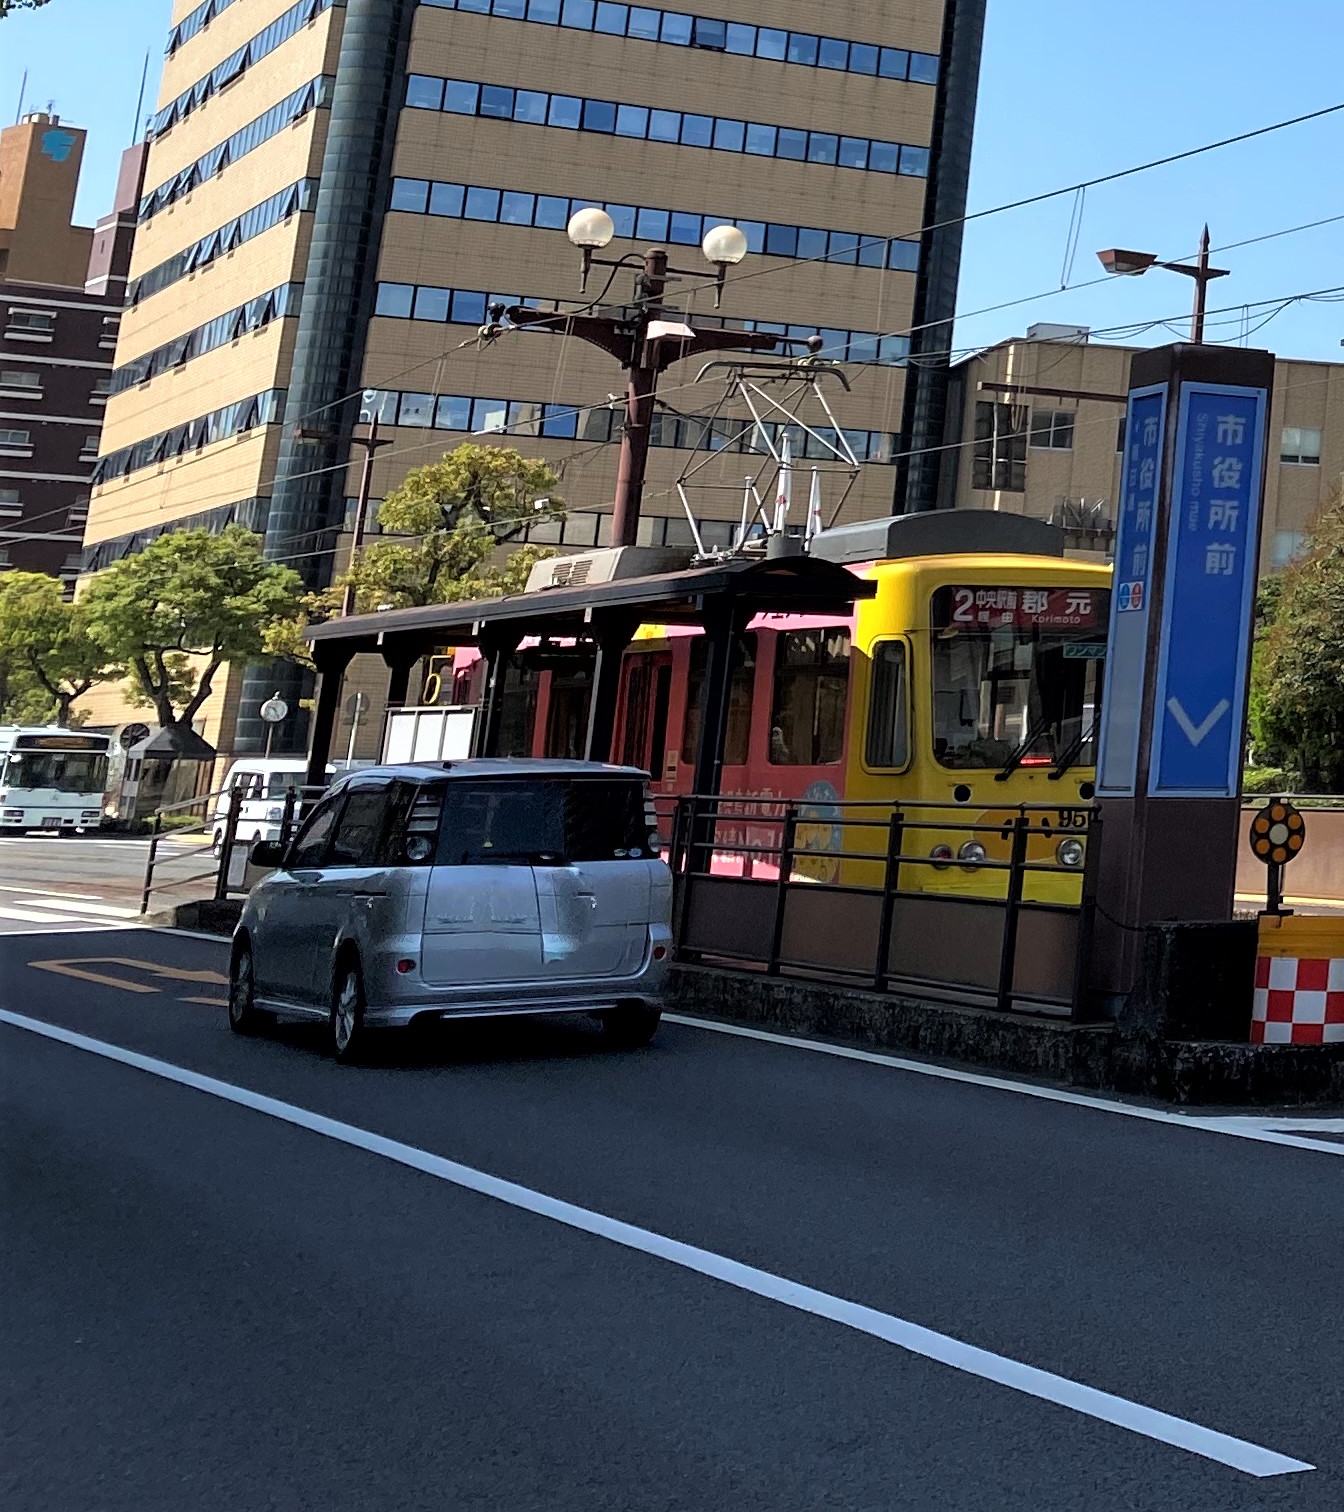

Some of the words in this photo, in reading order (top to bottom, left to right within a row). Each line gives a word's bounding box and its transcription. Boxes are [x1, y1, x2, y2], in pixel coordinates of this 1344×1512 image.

[1131, 416, 1159, 578] 市役所前
[1205, 413, 1247, 577] 市役所前
[953, 588, 975, 623] 2
[1031, 614, 1081, 624] Korimoto
